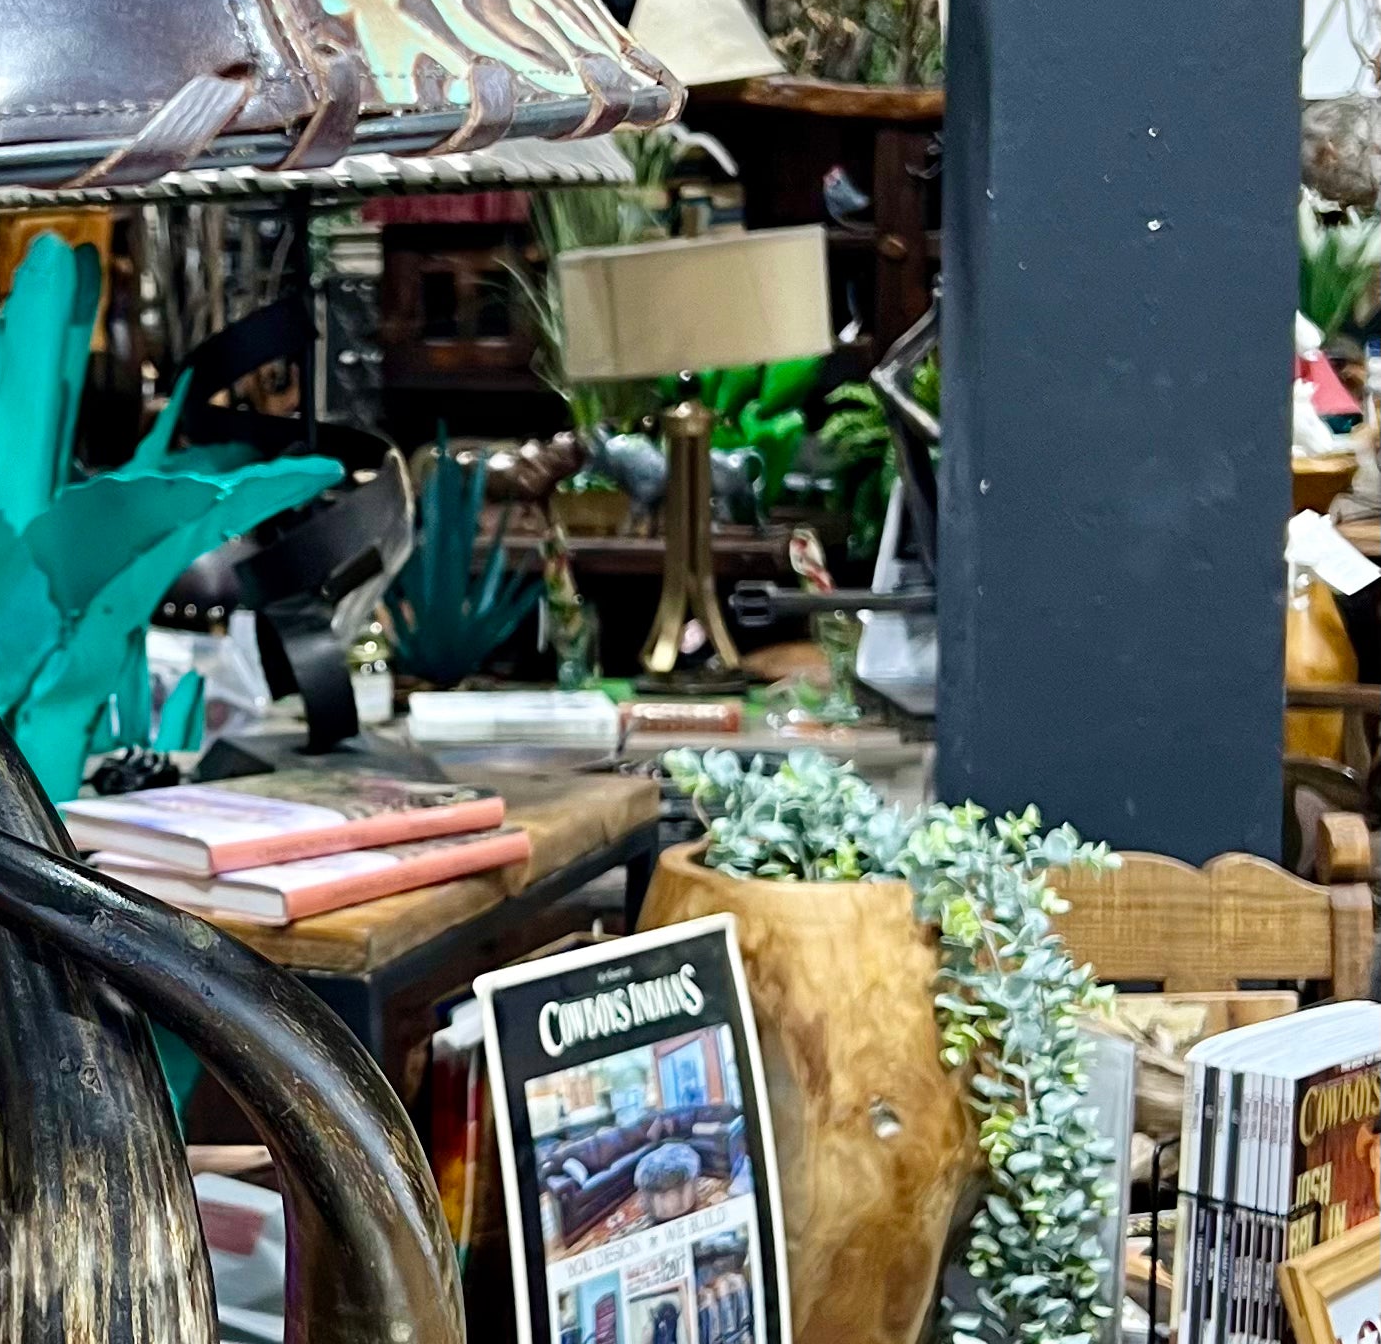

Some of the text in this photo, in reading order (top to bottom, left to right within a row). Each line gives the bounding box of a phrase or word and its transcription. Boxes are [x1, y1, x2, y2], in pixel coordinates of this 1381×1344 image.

[538, 963, 705, 1057] COWBOYS INDIANS
[1299, 1071, 1381, 1148] COWBOYS
